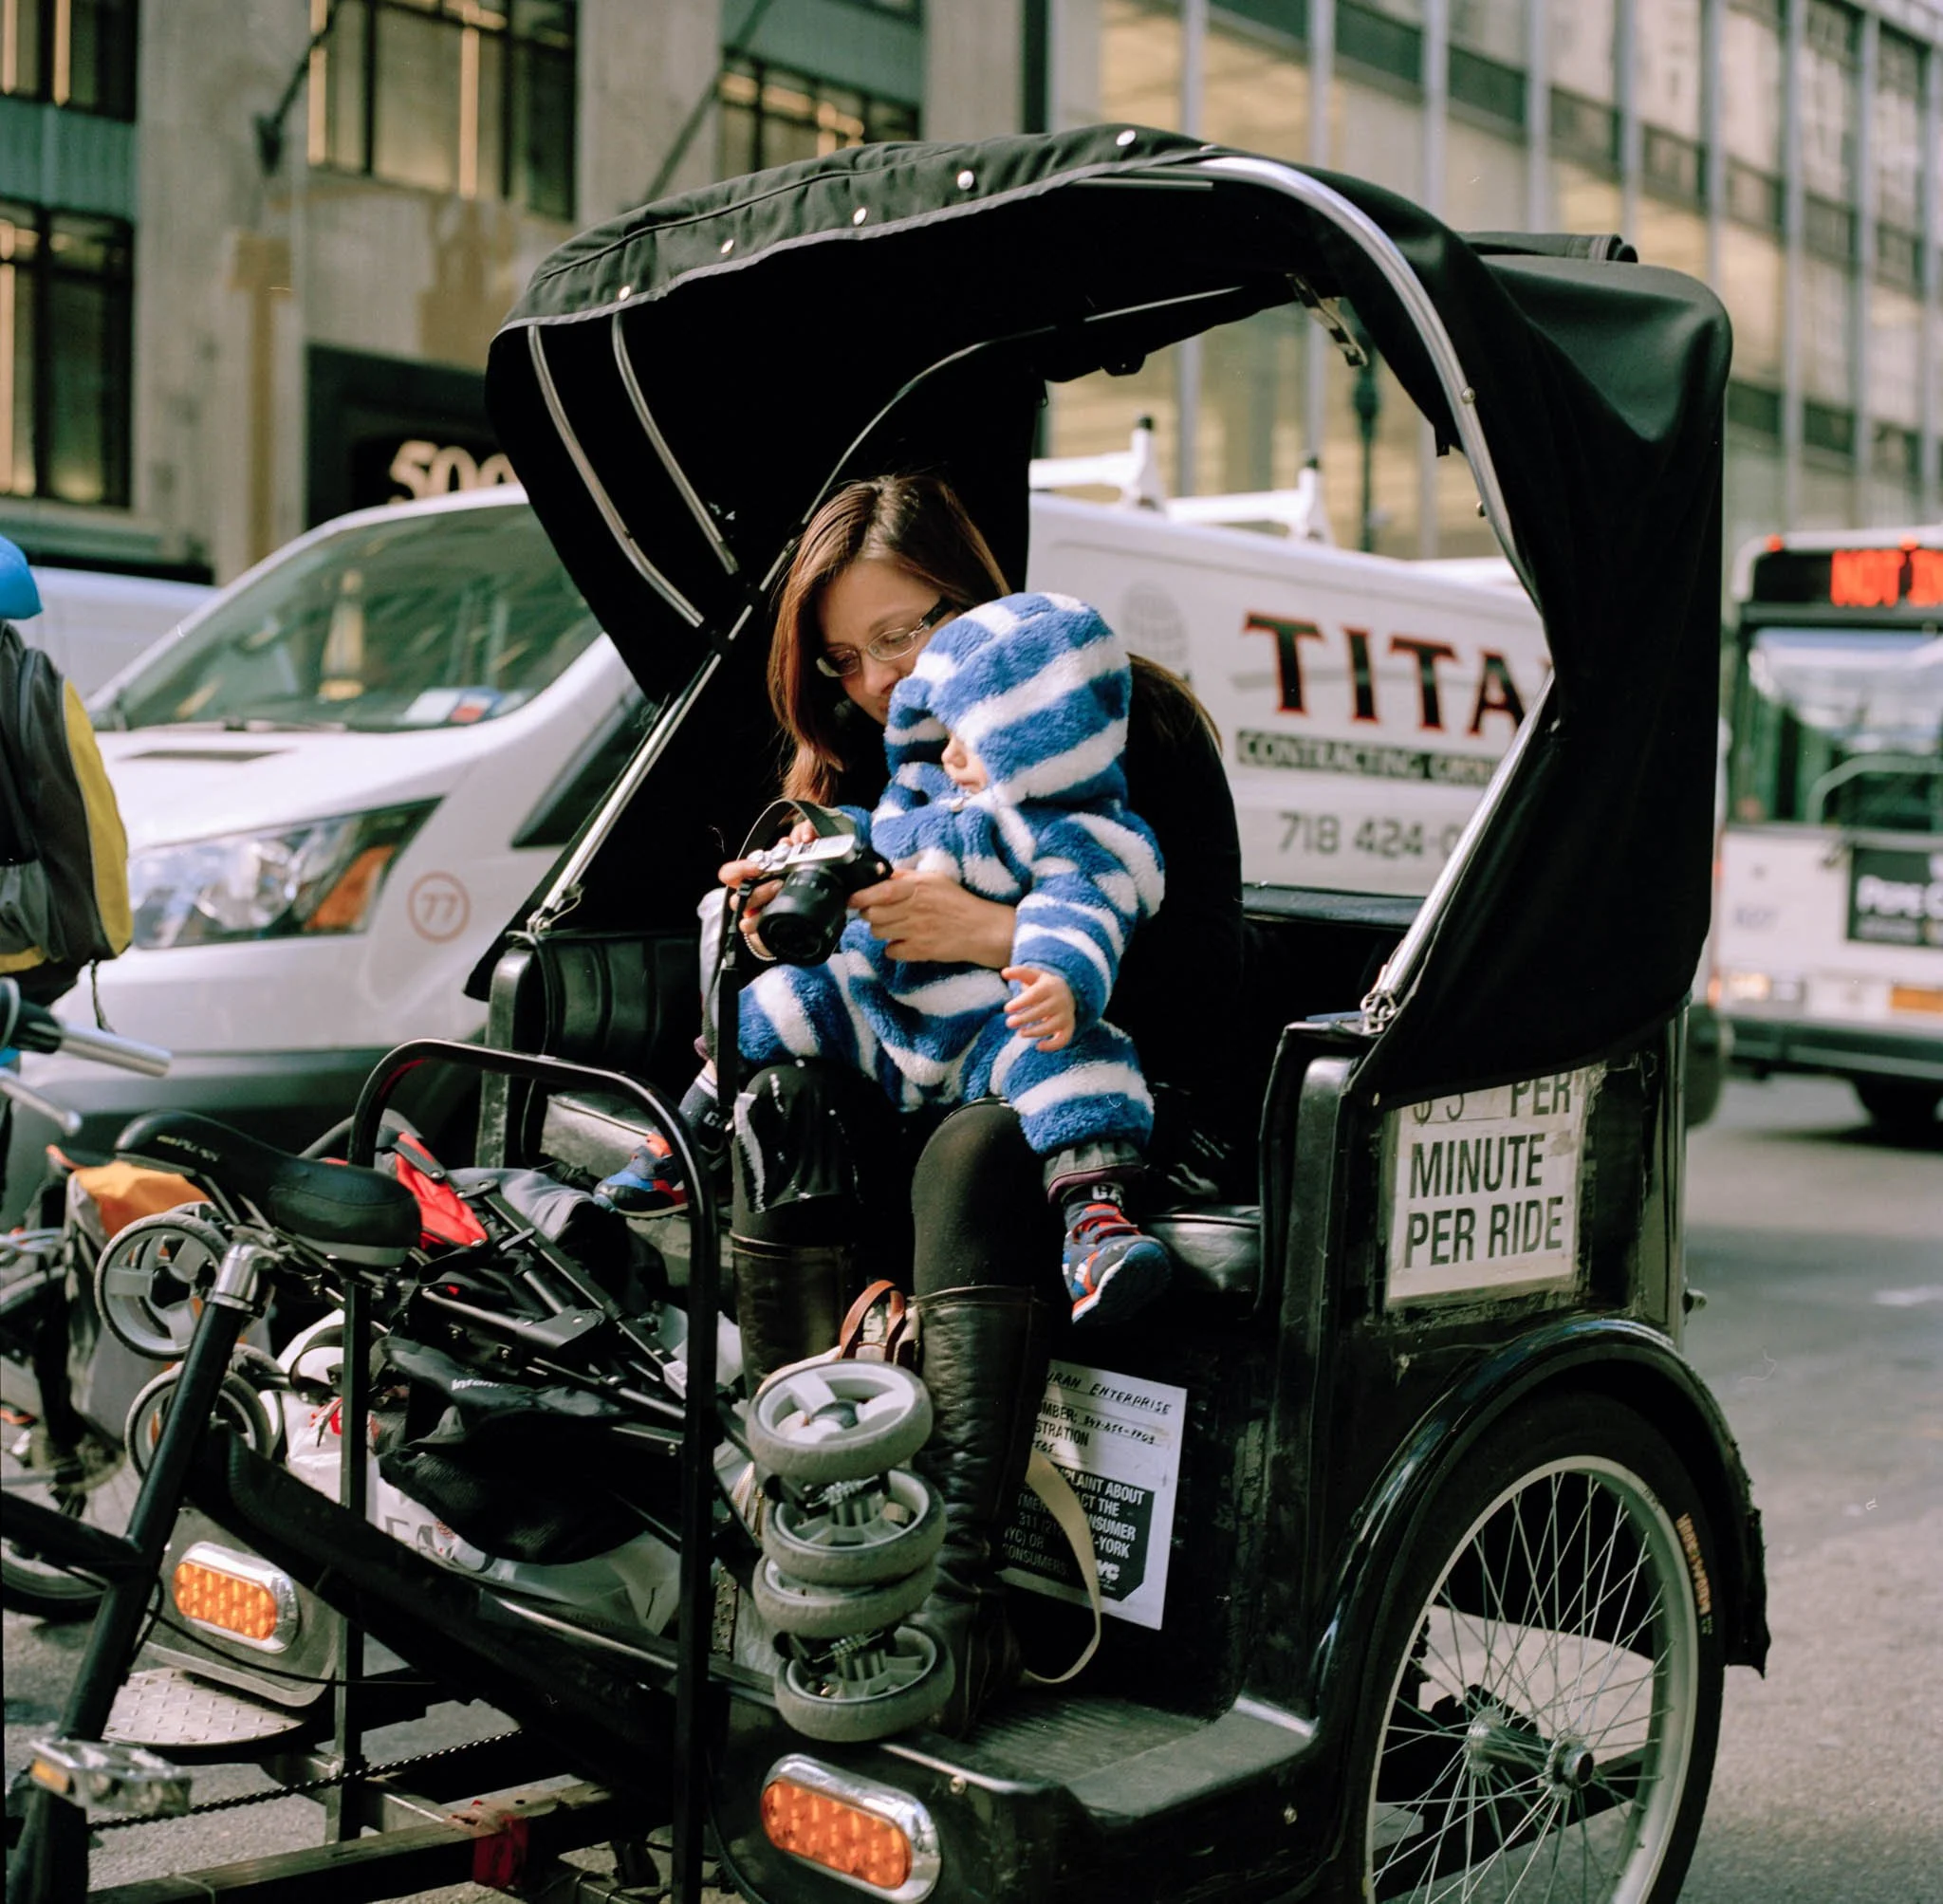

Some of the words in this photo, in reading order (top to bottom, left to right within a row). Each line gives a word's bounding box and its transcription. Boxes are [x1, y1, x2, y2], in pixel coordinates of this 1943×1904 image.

[1242, 610, 1553, 737] TITA
[1236, 730, 1428, 780] CONTRACTING
[1279, 810, 1341, 856] 718
[420, 893, 459, 924] 77
[1509, 1072, 1571, 1118] PER
[1409, 1133, 1545, 1198] MINUTE
[1404, 1207, 1476, 1268] PER
[1488, 1195, 1564, 1259] RIDE
[1089, 1383, 1172, 1415] ENTERPRISE
[1098, 1497, 1120, 1518] THE
[1105, 1481, 1146, 1506] ABOUT
[1091, 1533, 1130, 1560] -YORK
